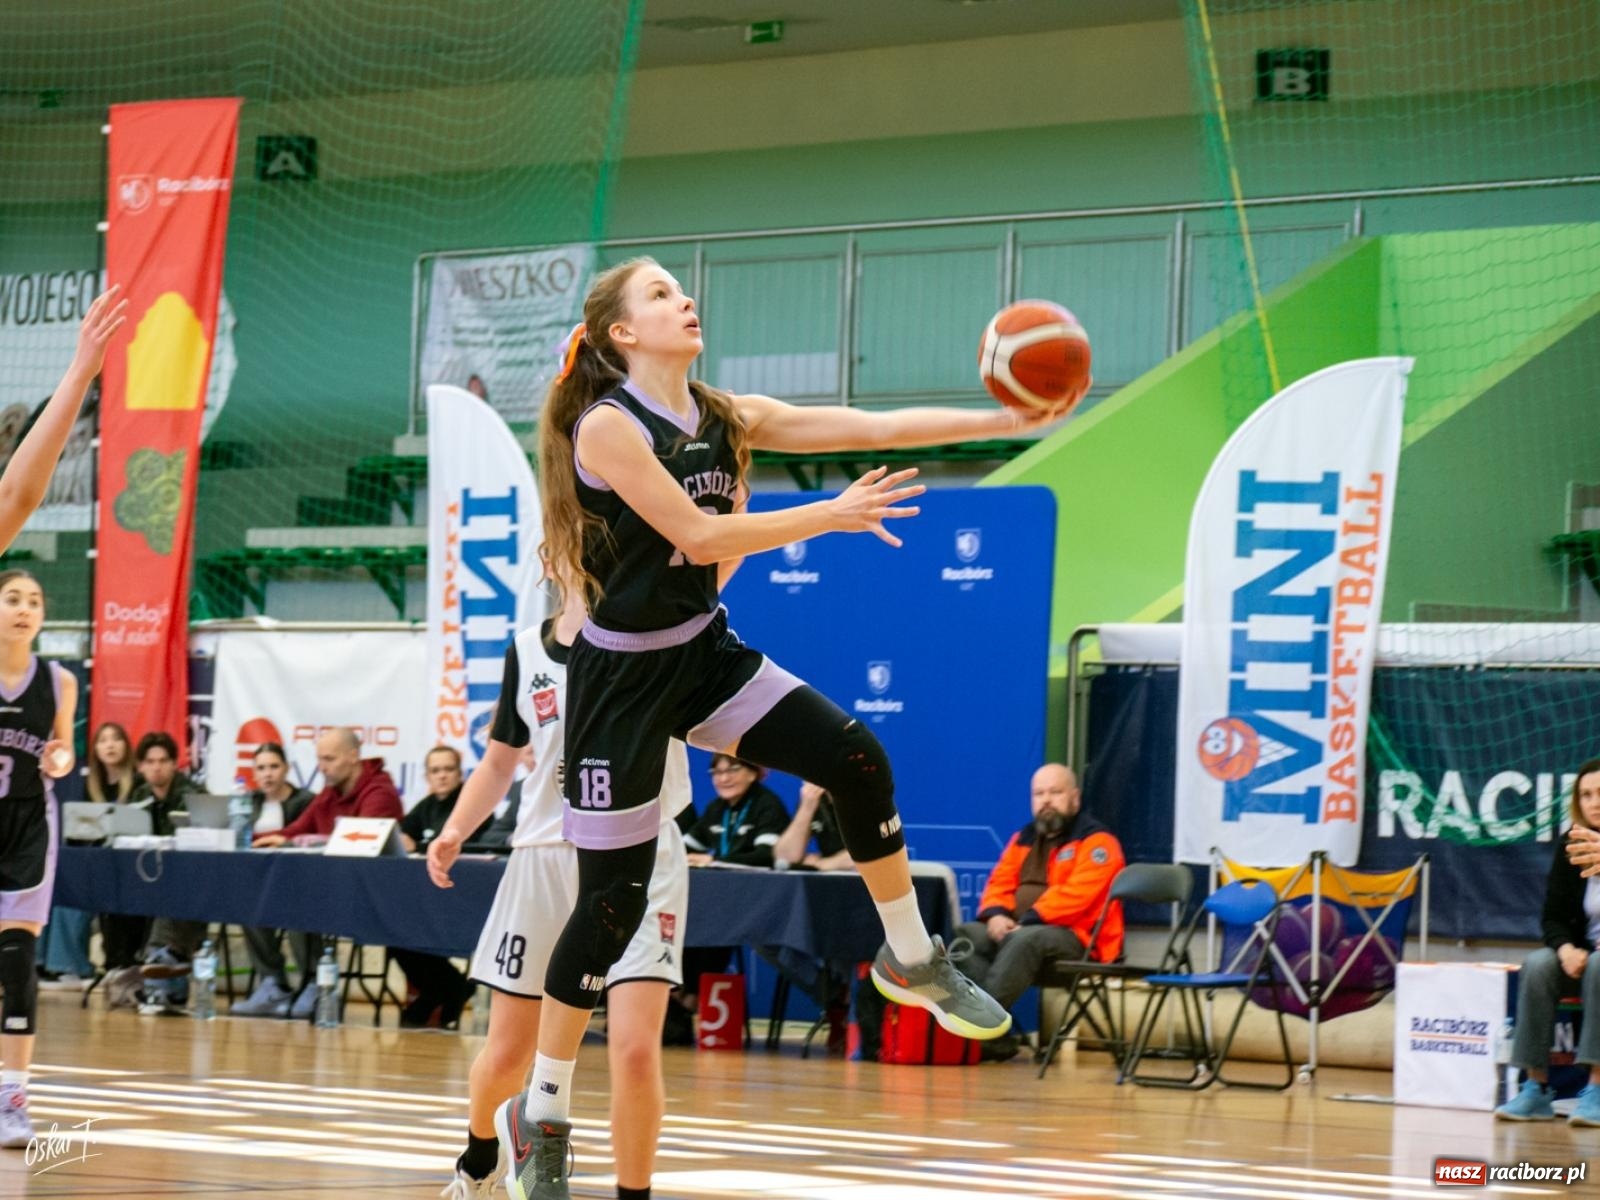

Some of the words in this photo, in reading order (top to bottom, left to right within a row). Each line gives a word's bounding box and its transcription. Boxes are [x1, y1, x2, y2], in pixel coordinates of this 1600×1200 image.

[1273, 67, 1311, 95] B
[267, 149, 306, 175] A
[1221, 470, 1341, 825] MINI
[1322, 472, 1384, 824] BASKETBALL
[579, 767, 613, 809] 18
[494, 931, 527, 980] 48
[700, 981, 733, 1032] 5
[1411, 1015, 1490, 1037] RACIBÓRZ
[1411, 1038, 1489, 1056] BASKETBALL
